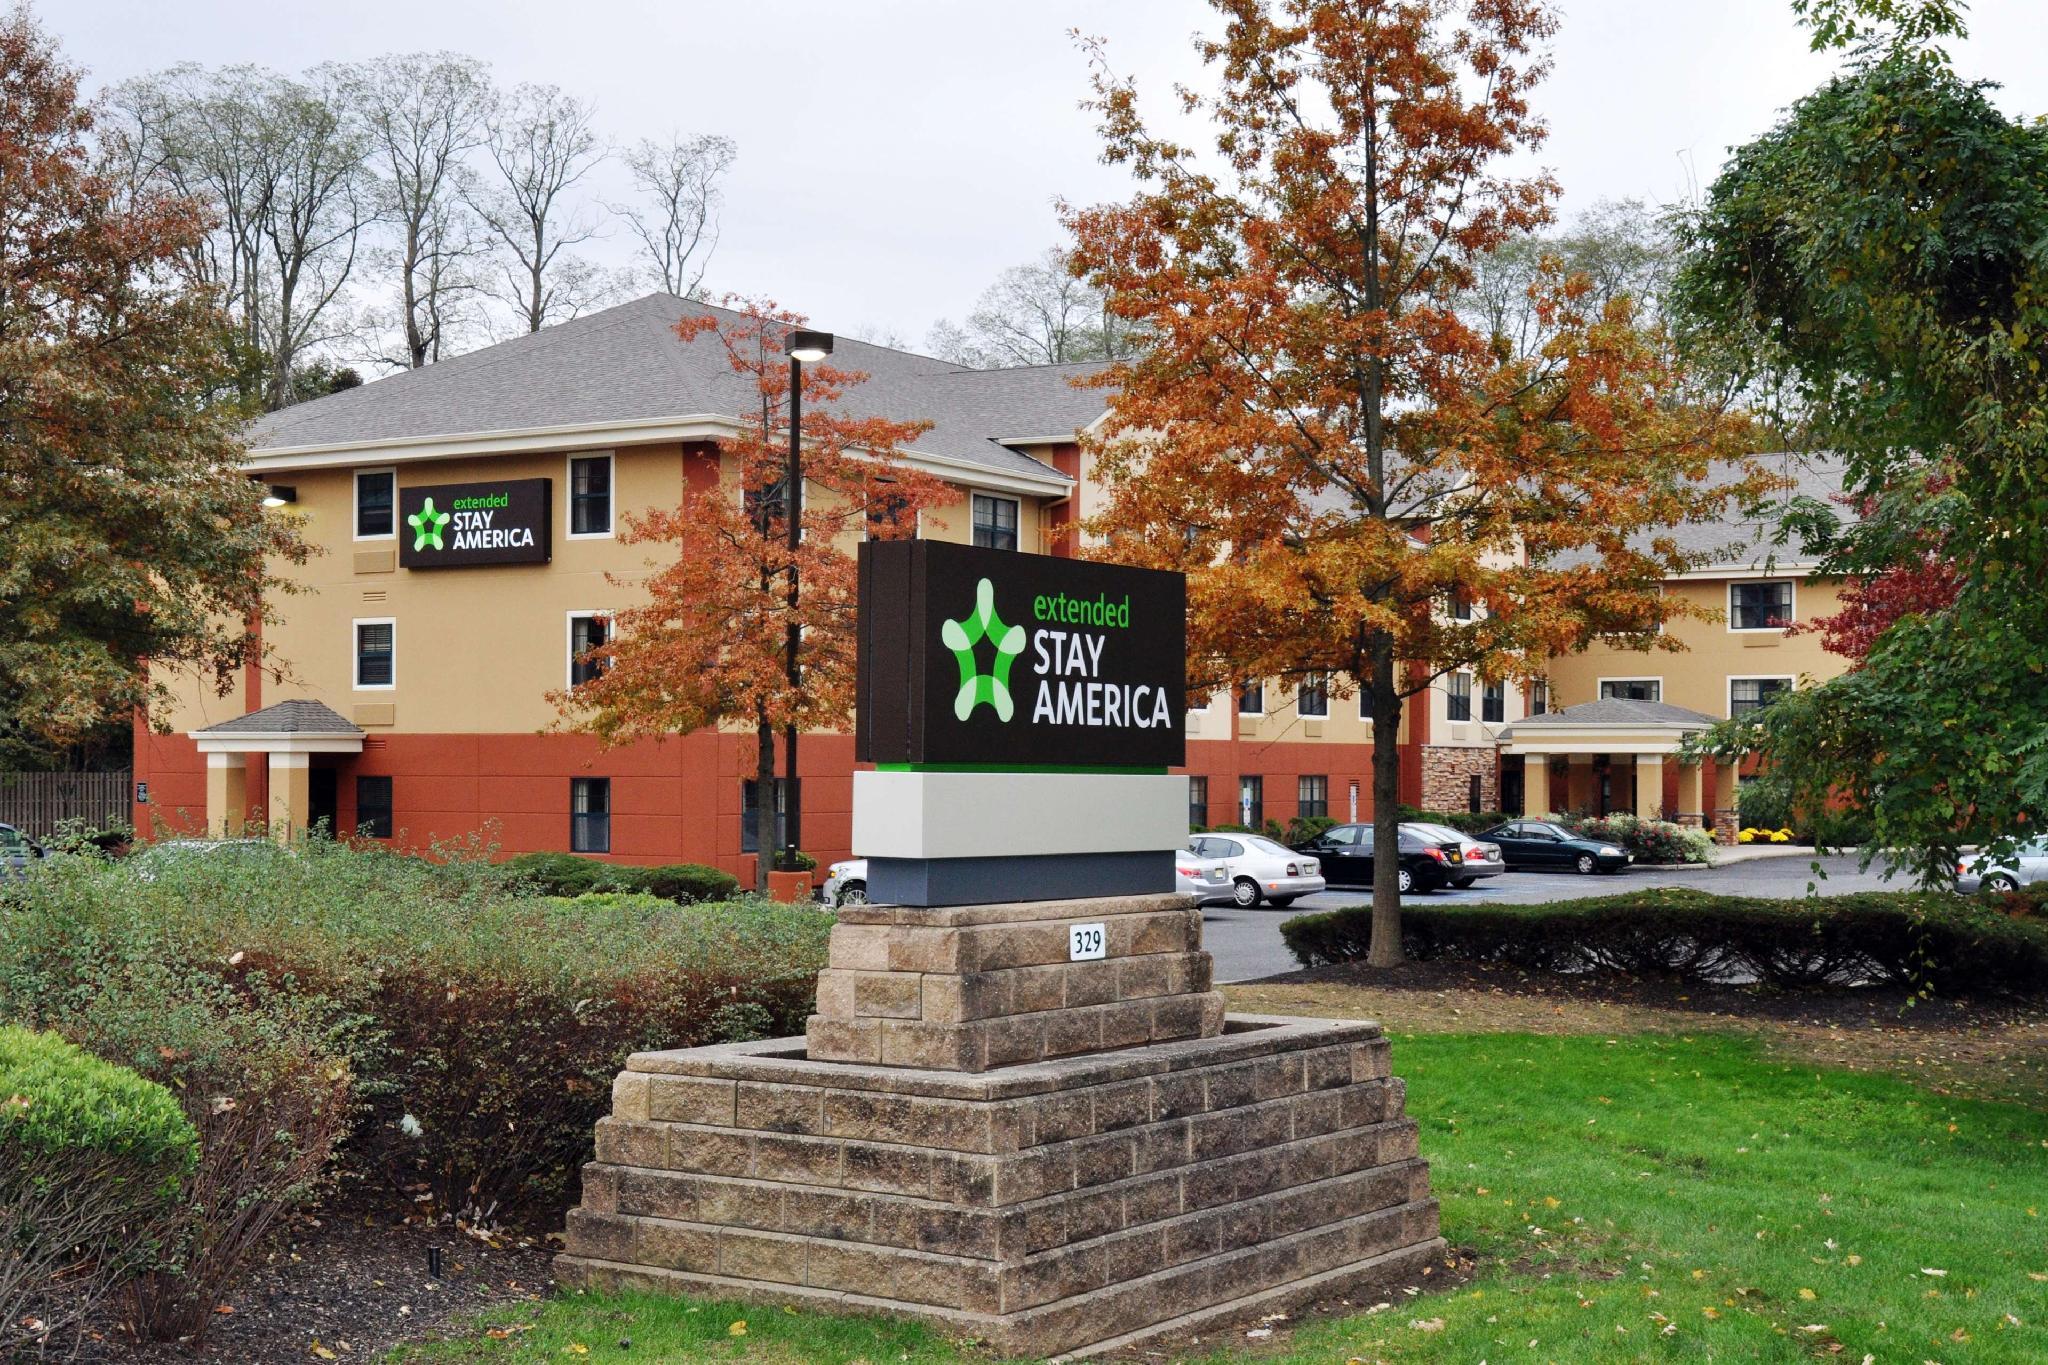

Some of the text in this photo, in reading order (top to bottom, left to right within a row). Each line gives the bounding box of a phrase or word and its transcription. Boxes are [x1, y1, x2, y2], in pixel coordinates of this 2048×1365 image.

[453, 492, 508, 510] extended
[453, 510, 494, 531] STAY
[452, 528, 534, 550] AMERICA
[1033, 592, 1129, 629] extended
[1033, 629, 1106, 678] STAY
[1032, 680, 1171, 729] AMERICA
[1075, 930, 1101, 954] 329
